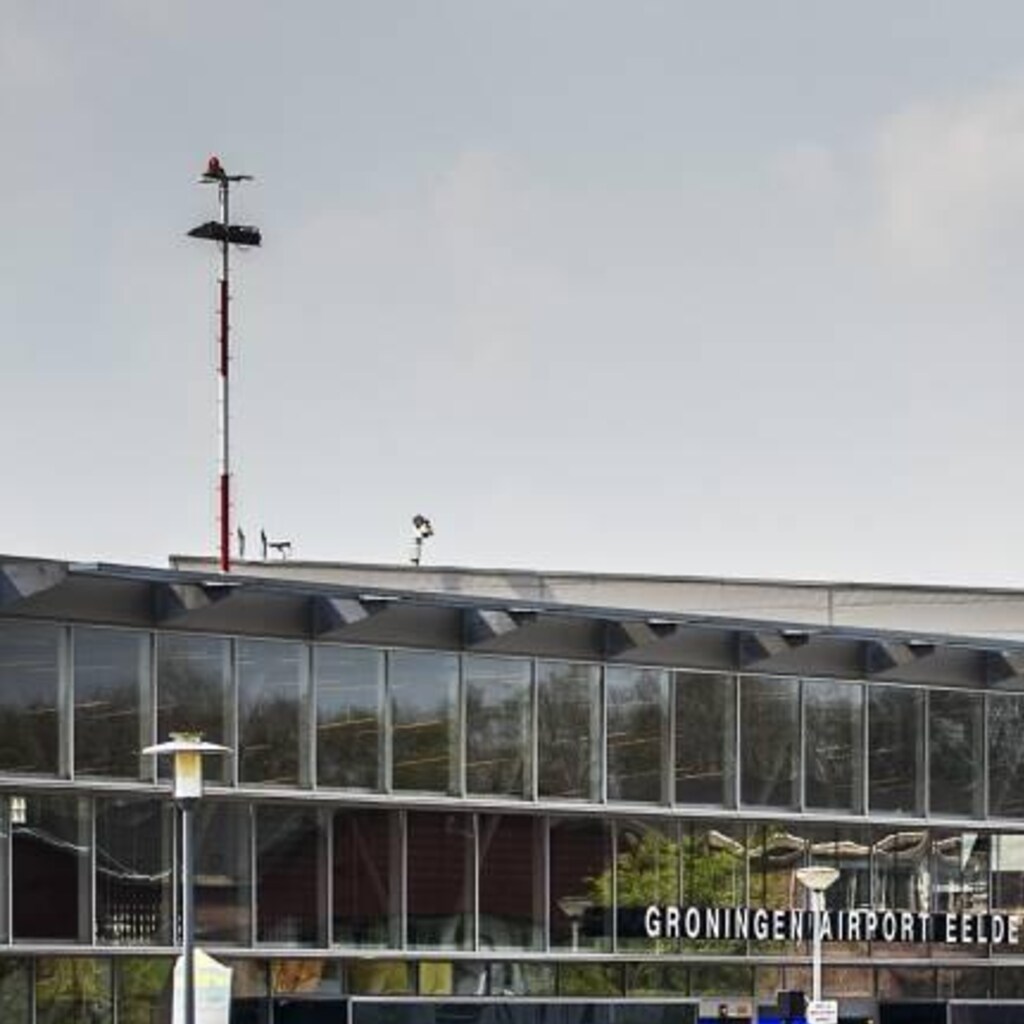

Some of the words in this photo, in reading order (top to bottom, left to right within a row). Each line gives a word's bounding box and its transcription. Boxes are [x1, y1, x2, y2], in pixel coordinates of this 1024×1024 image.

[644, 905, 803, 939] GRONINGEN
[819, 911, 929, 941] AIRPORT
[946, 913, 1019, 944] EELDE
